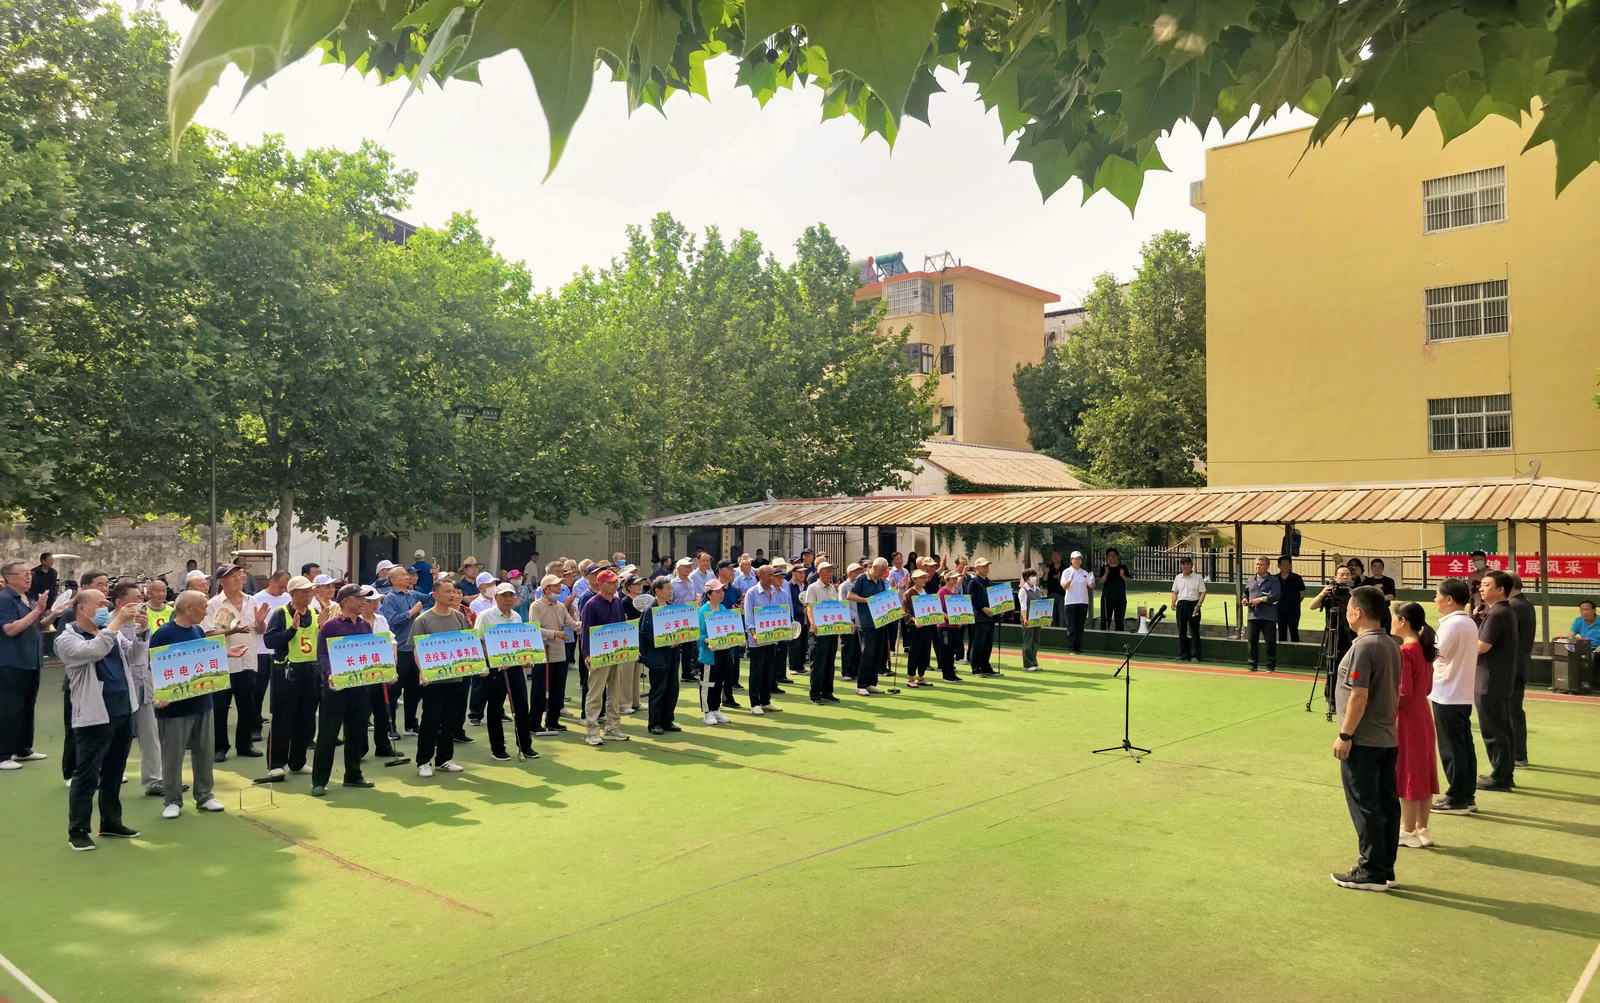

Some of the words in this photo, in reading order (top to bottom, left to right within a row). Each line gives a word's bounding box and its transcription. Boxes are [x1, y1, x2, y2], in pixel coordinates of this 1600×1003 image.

[300, 637, 312, 654] 5
[500, 639, 531, 650] 财政局
[346, 652, 380, 667] 长桥镇
[424, 647, 479, 663] 退役军人事务局
[163, 658, 219, 681] 供电公司
